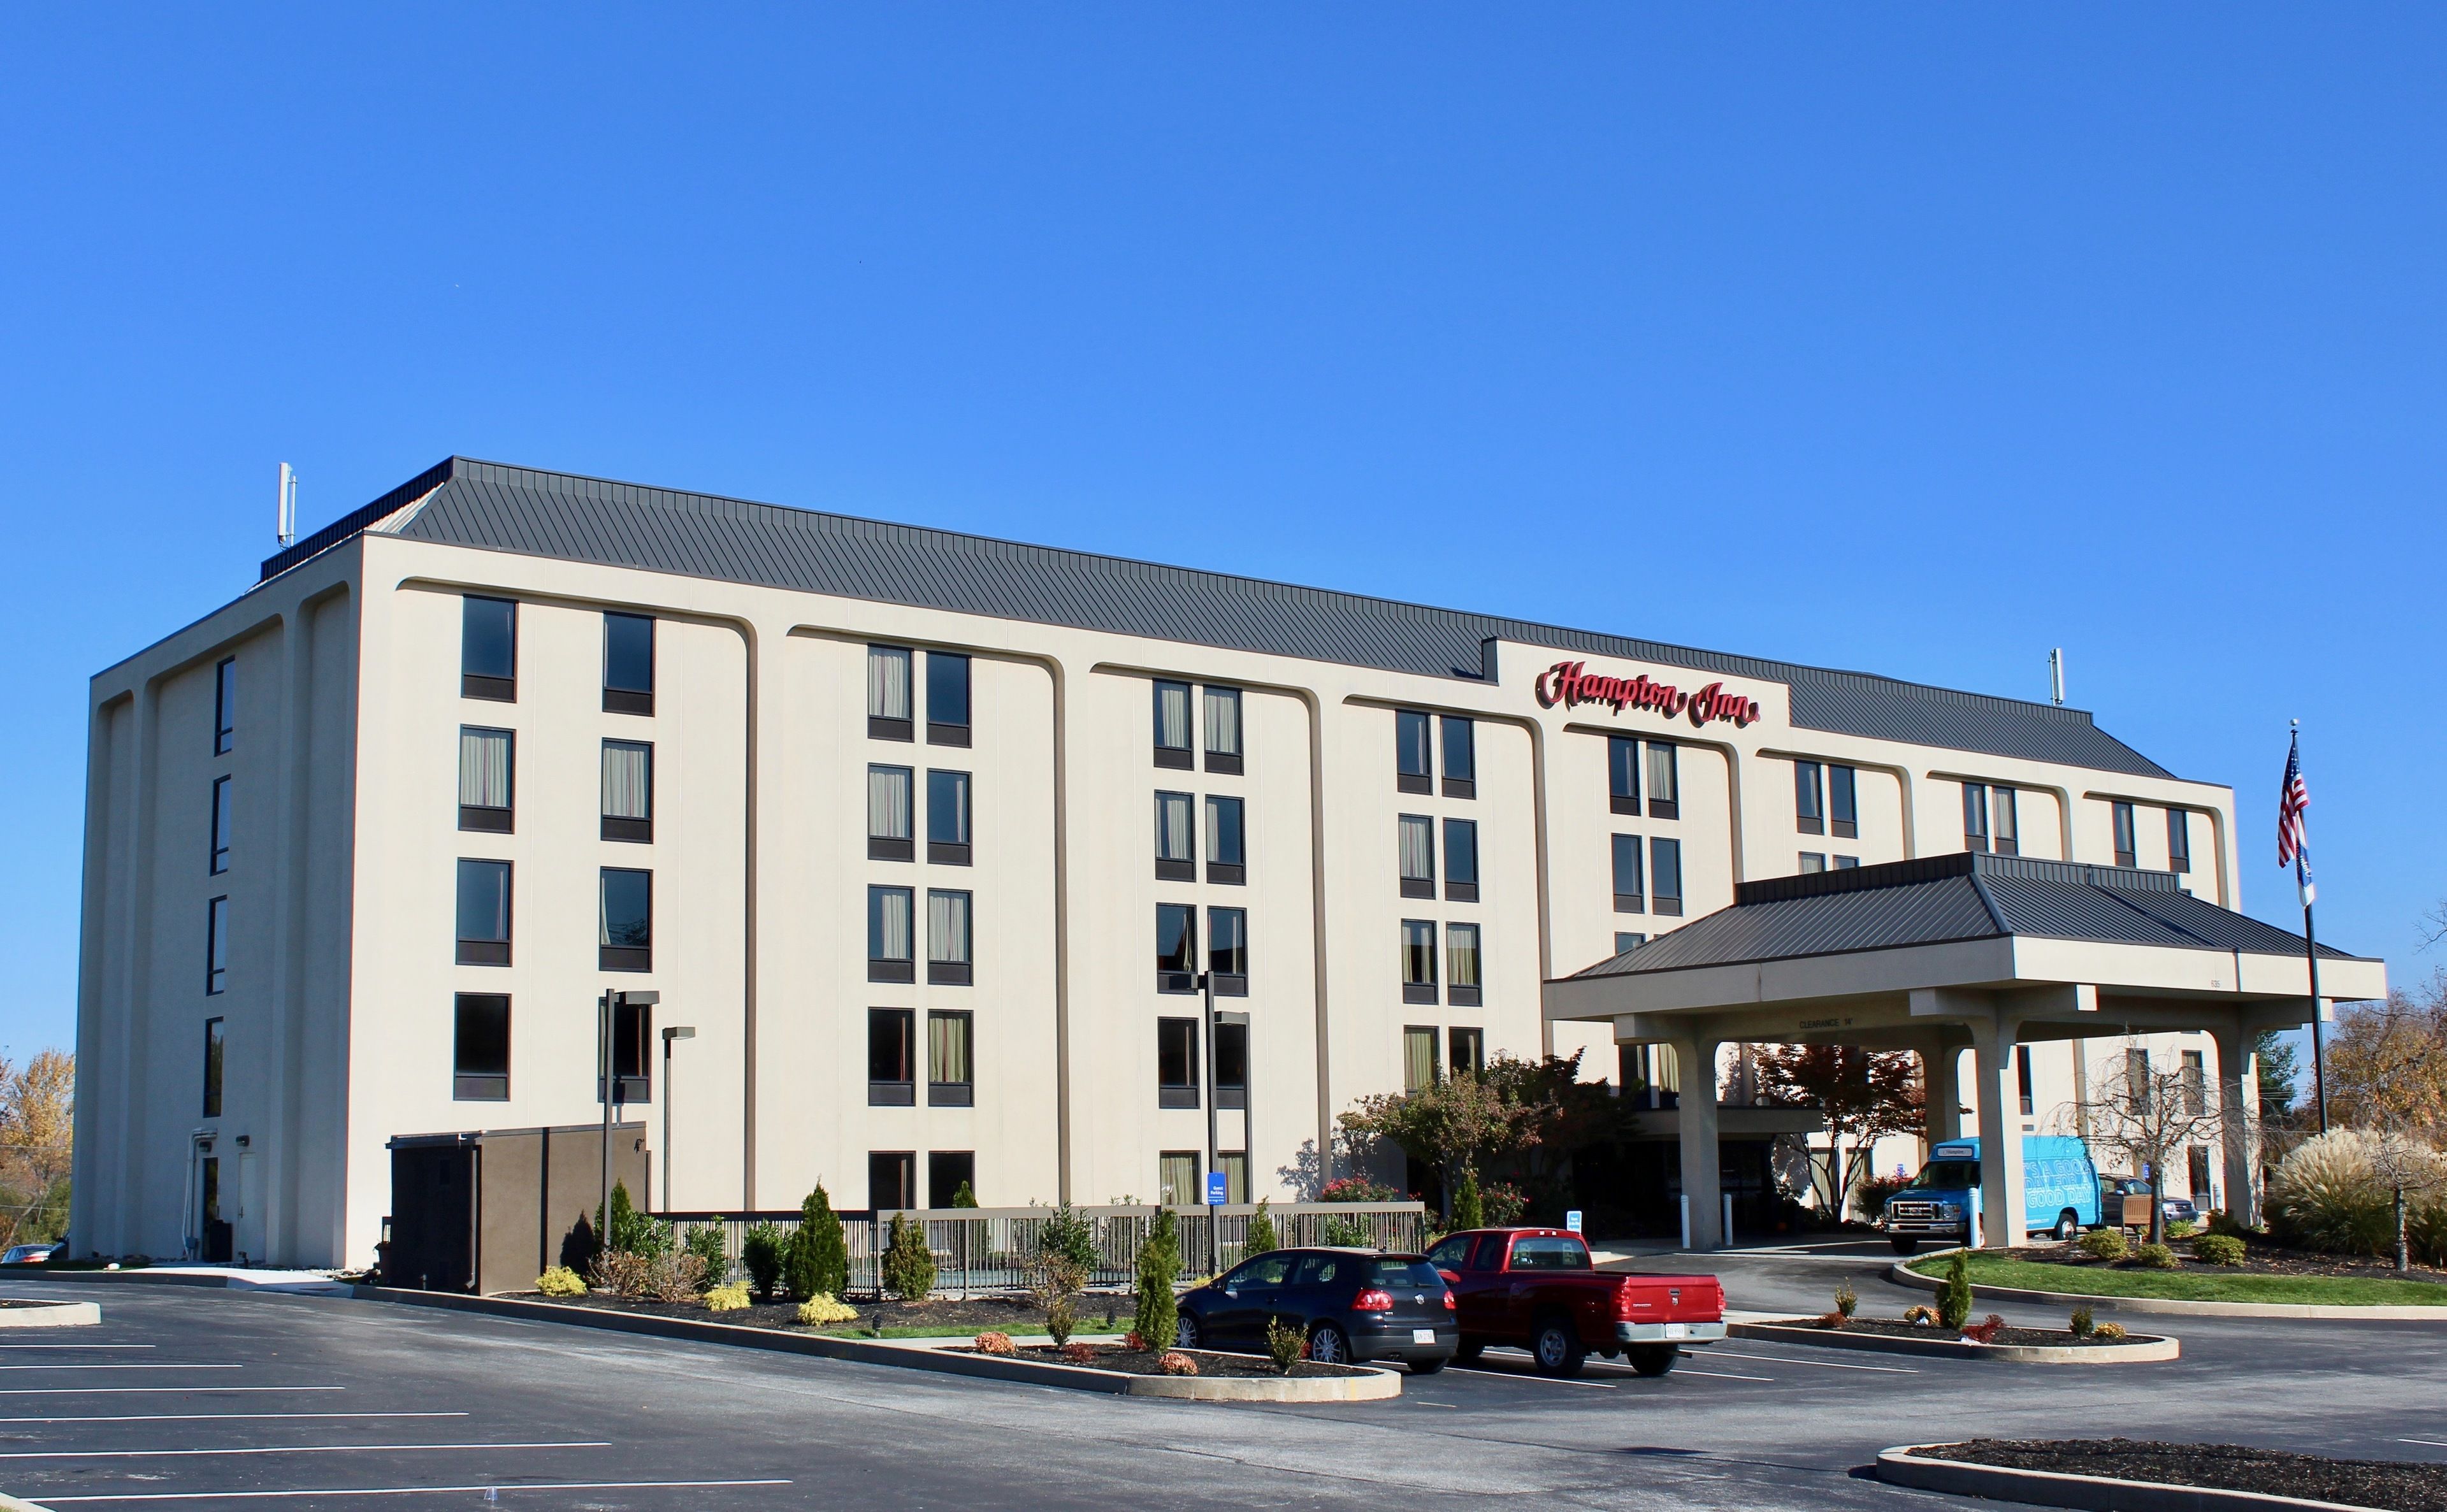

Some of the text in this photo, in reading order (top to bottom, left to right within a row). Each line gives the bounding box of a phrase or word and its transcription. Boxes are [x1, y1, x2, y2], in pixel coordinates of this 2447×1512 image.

[1535, 661, 1759, 728] Hampton Inn
[1800, 1019, 1840, 1029] CLEARANCE
[2054, 1159, 2091, 1174] GOOD
[2023, 1176, 2050, 1192] DAY
[2054, 1173, 2078, 1191] FOR
[2027, 1189, 2064, 1208] GOOD
